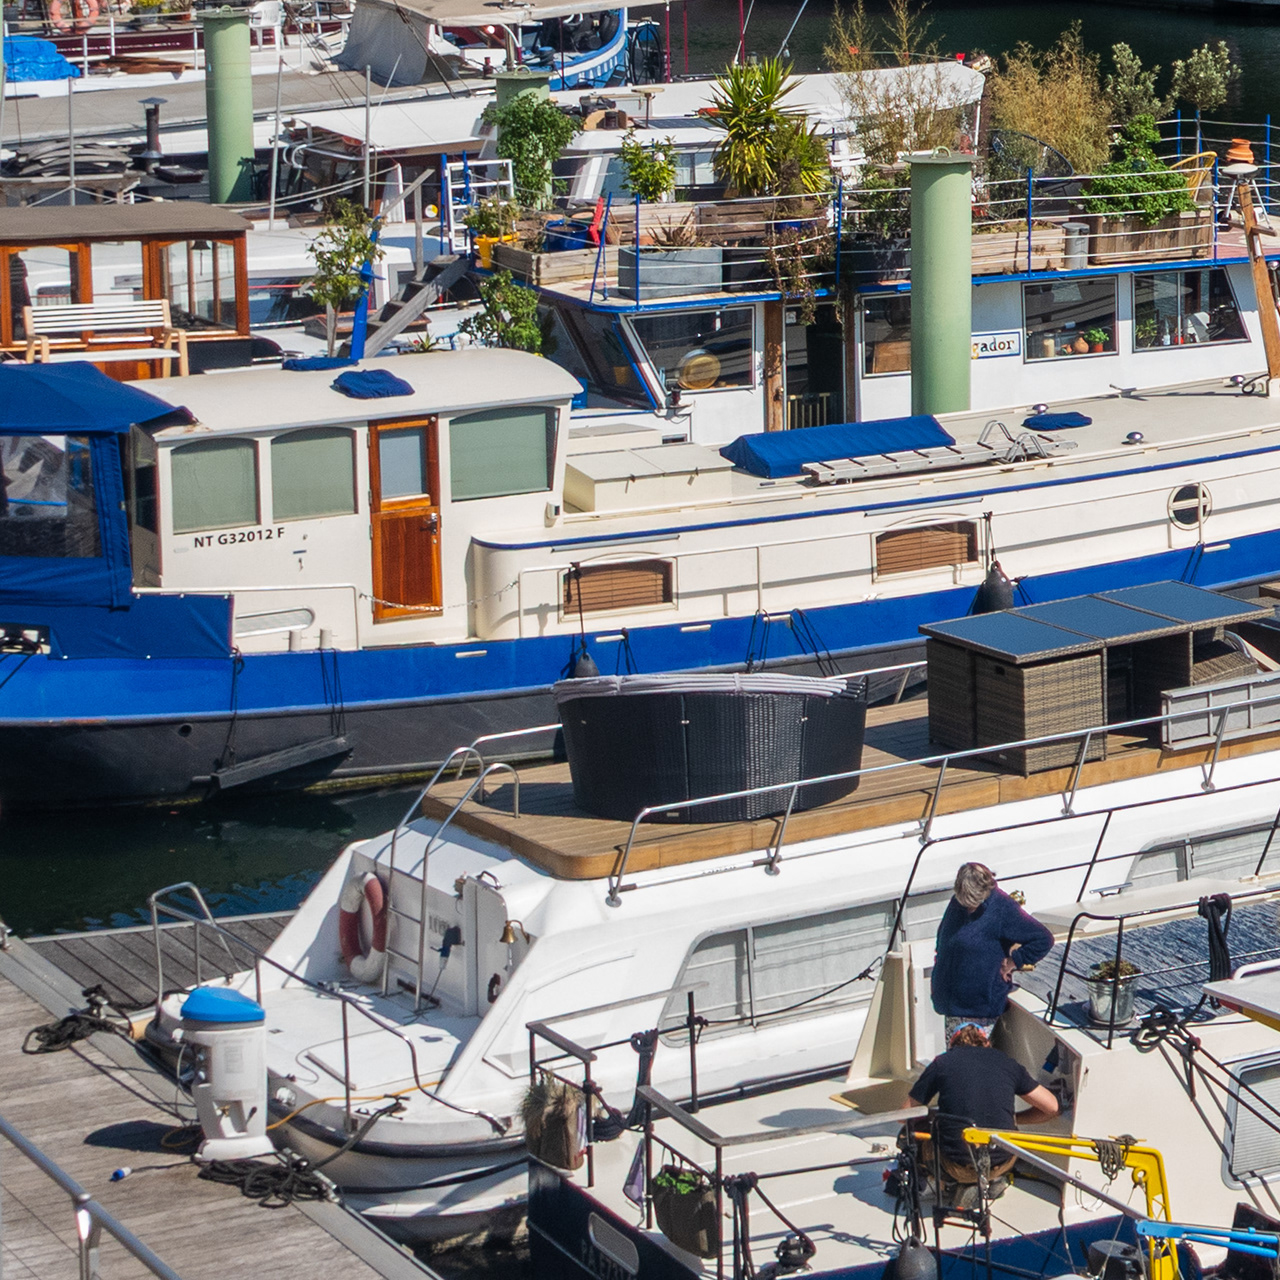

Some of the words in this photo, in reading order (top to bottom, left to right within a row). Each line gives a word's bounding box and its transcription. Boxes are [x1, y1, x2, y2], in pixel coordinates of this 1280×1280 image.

[971, 336, 1014, 359] gador
[194, 535, 213, 548] NT
[217, 529, 273, 545] G32012
[277, 527, 285, 538] F
